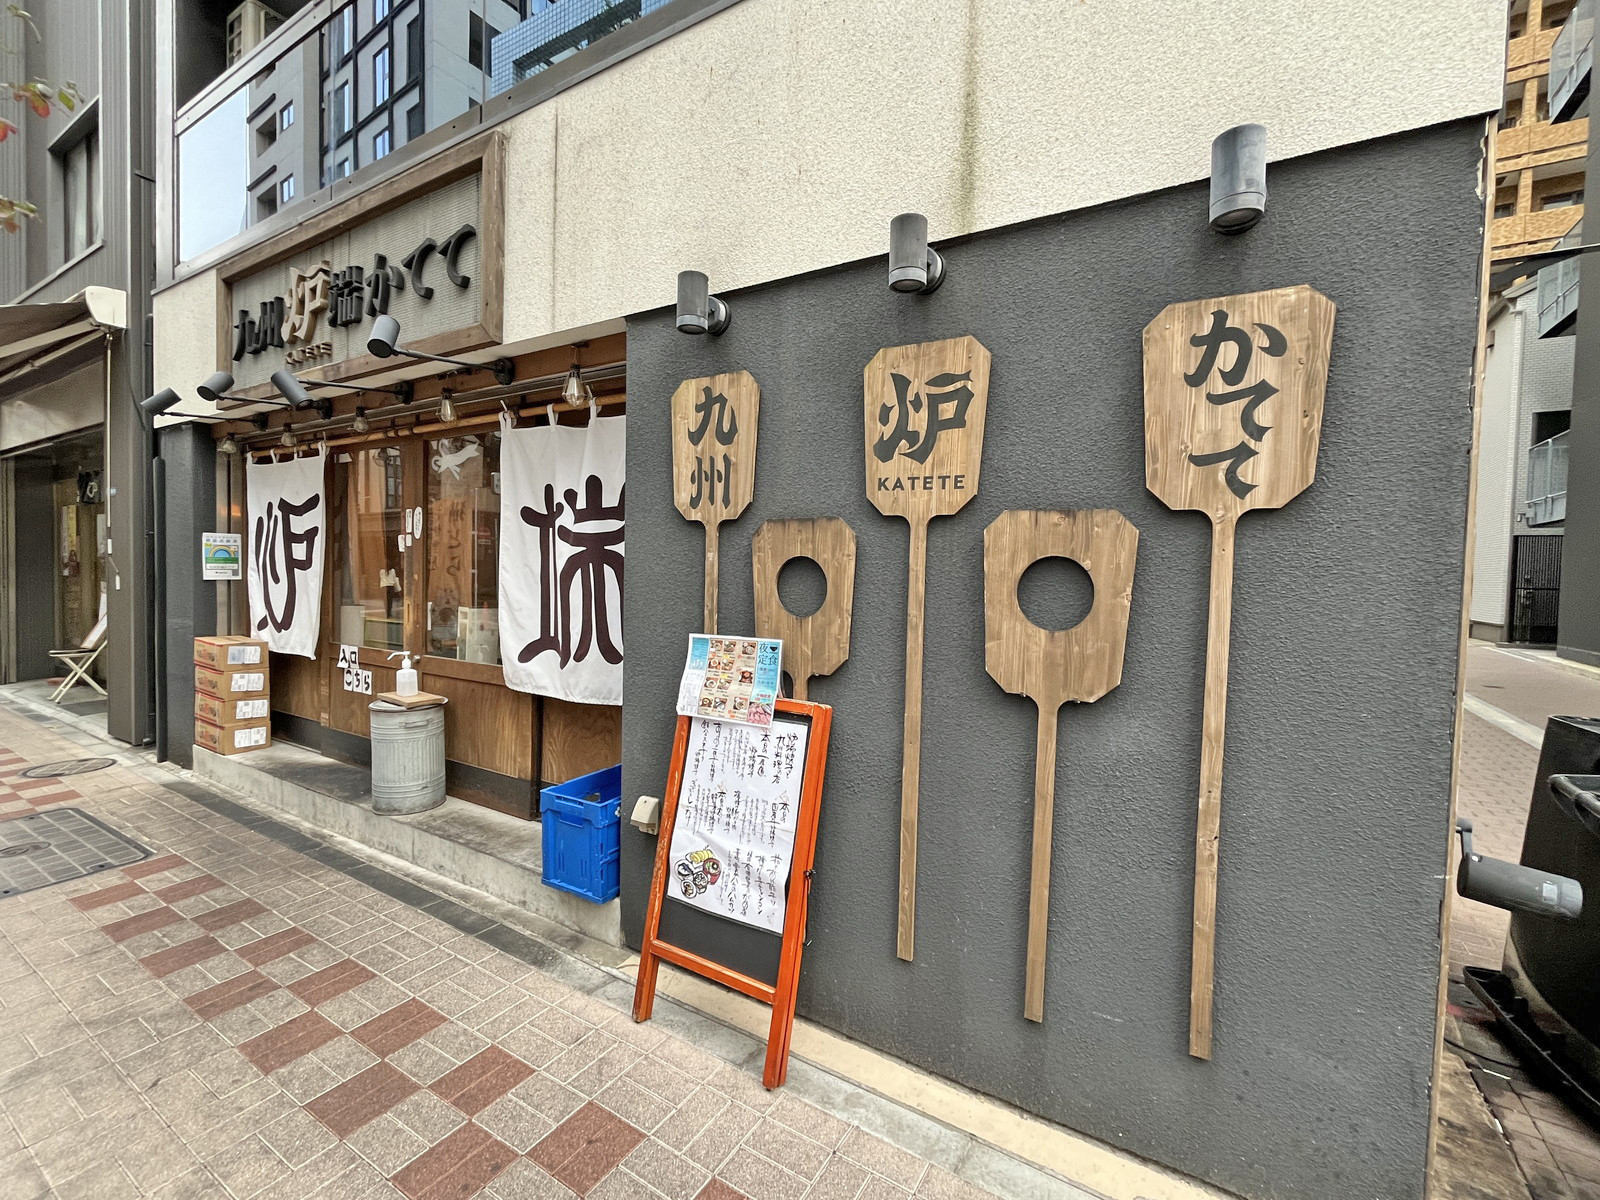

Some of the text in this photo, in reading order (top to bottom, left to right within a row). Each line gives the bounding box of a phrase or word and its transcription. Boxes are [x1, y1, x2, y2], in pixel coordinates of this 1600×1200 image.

[688, 386, 738, 510] 九州
[873, 370, 975, 465] 炉
[1184, 309, 1288, 500] かてて
[878, 474, 966, 491] KATETE
[255, 493, 321, 633] 炉
[340, 648, 357, 665] 入口
[345, 669, 370, 691] こちら
